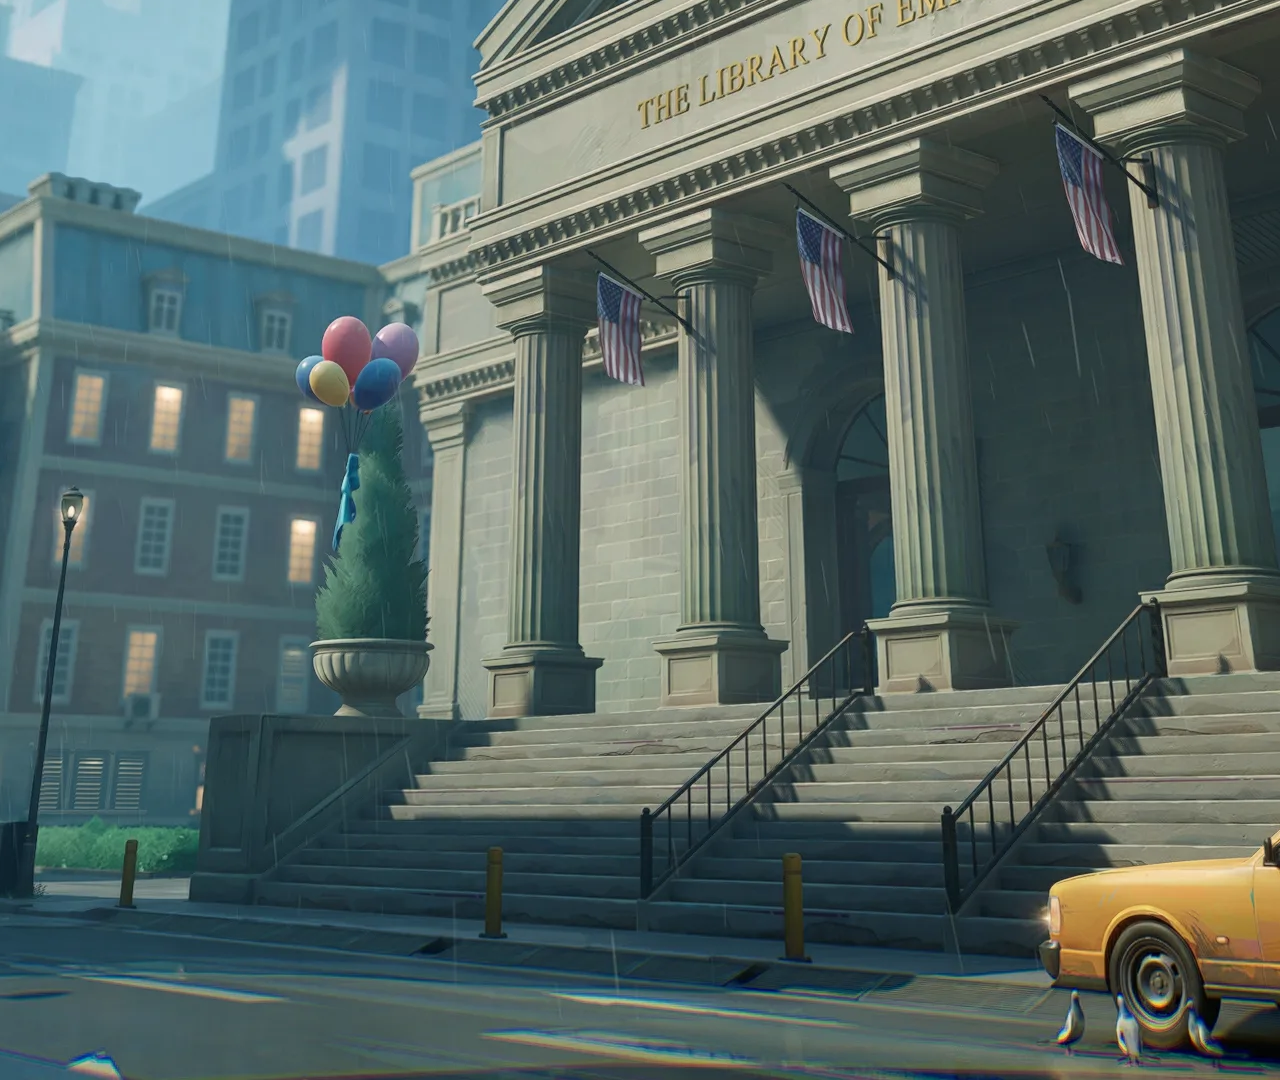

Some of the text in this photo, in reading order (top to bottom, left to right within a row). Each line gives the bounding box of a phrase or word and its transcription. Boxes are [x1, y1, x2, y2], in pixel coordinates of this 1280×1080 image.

[637, 83, 690, 129] THE
[698, 23, 831, 106] LIBRARY
[842, 2, 883, 47] OF
